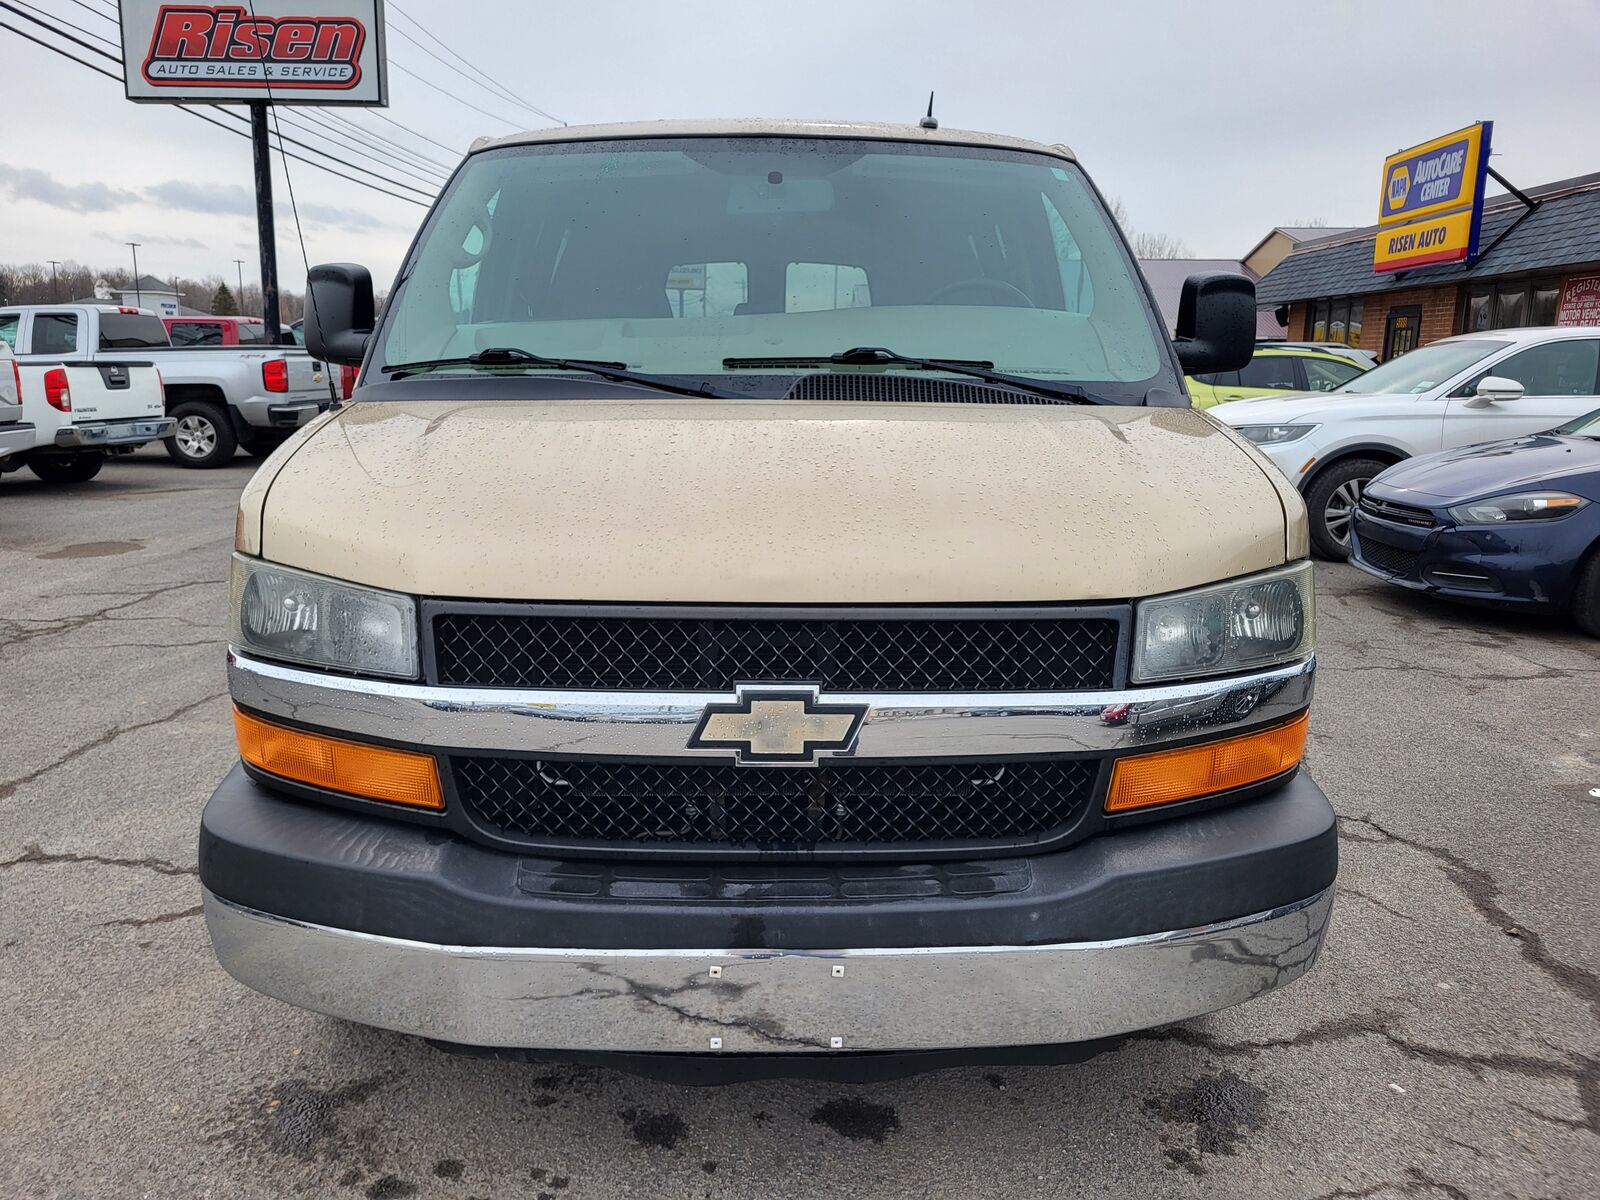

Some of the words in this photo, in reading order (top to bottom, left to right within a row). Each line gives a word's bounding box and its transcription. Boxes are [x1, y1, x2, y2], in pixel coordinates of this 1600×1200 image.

[155, 12, 358, 60] Risen
[156, 64, 199, 75] AUTO
[206, 65, 257, 76] SALES
[264, 66, 274, 76] &
[281, 67, 349, 77] SERVICE
[1421, 177, 1450, 201] CENTER
[1388, 232, 1417, 255] RISEN
[1417, 226, 1447, 248] AUTO
[1560, 310, 1581, 320] MOTOR
